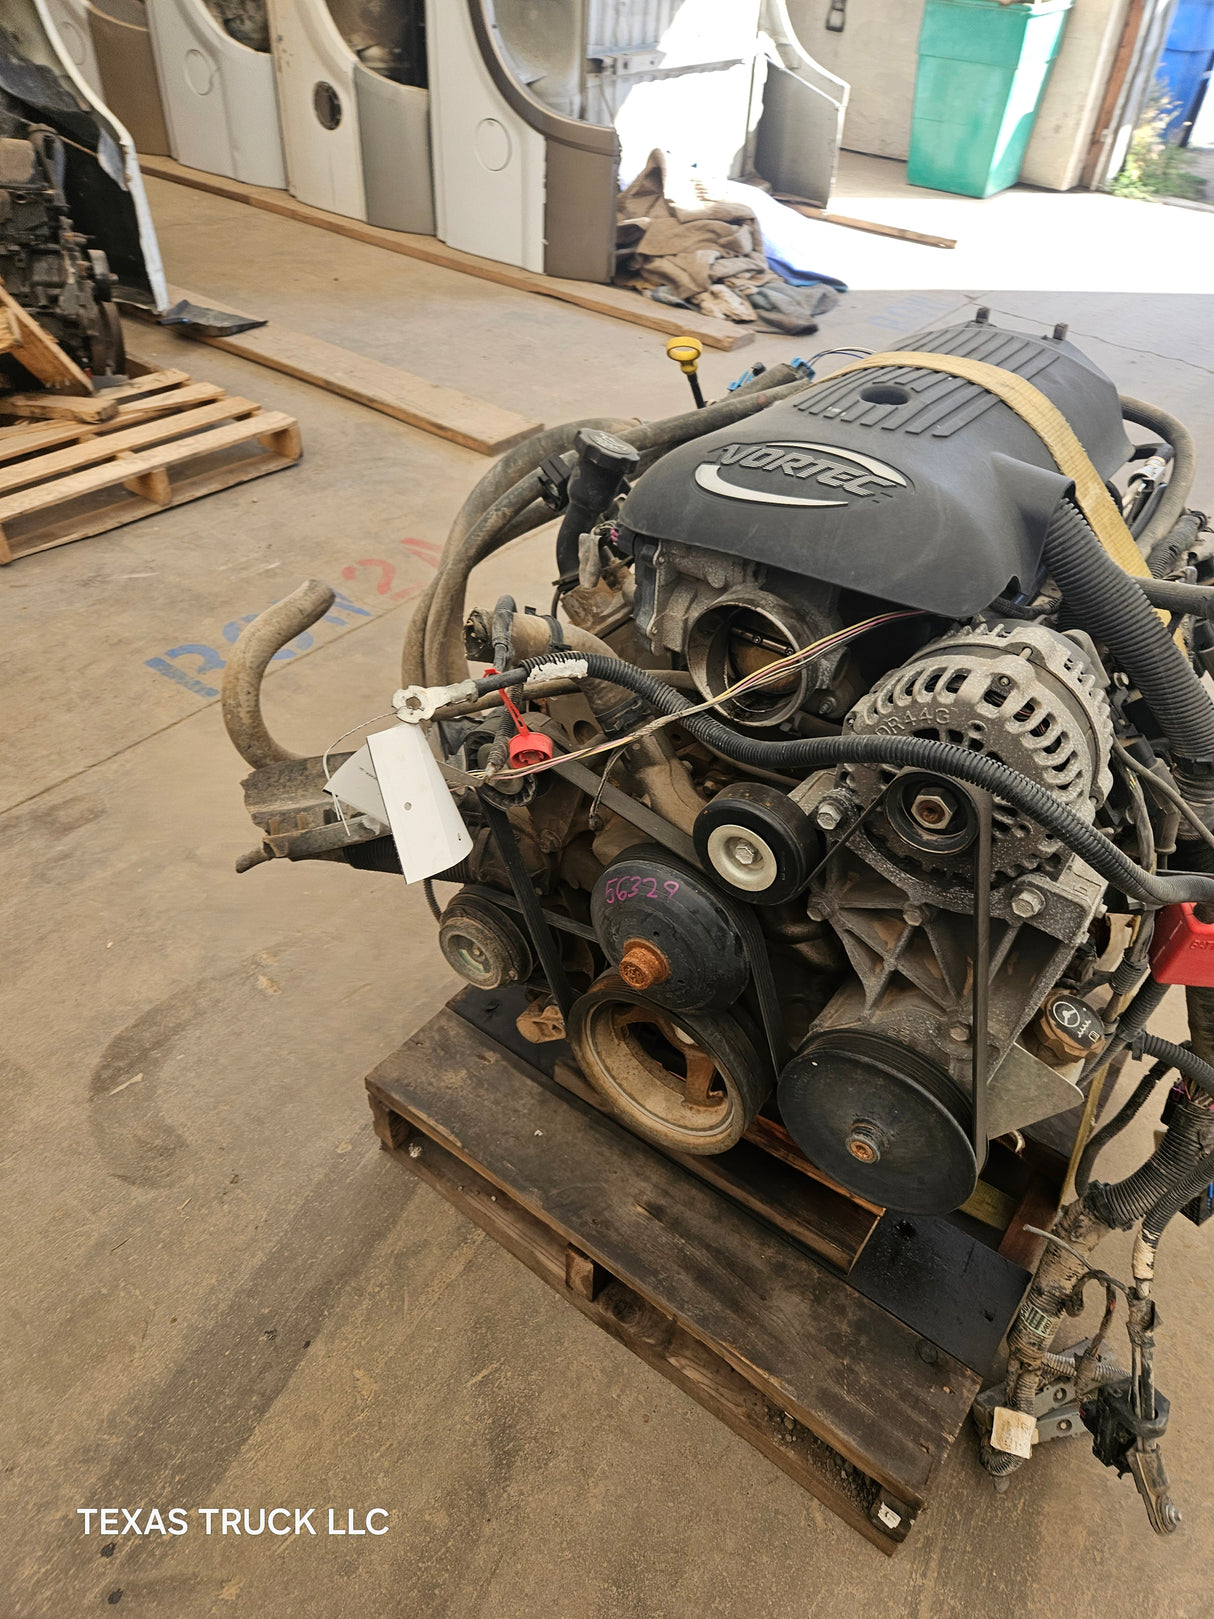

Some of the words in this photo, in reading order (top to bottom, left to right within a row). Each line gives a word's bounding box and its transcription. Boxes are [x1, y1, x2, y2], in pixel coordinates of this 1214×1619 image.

[719, 443, 897, 497] VORTEC
[875, 707, 950, 735] DR44G
[604, 875, 680, 904] 56329
